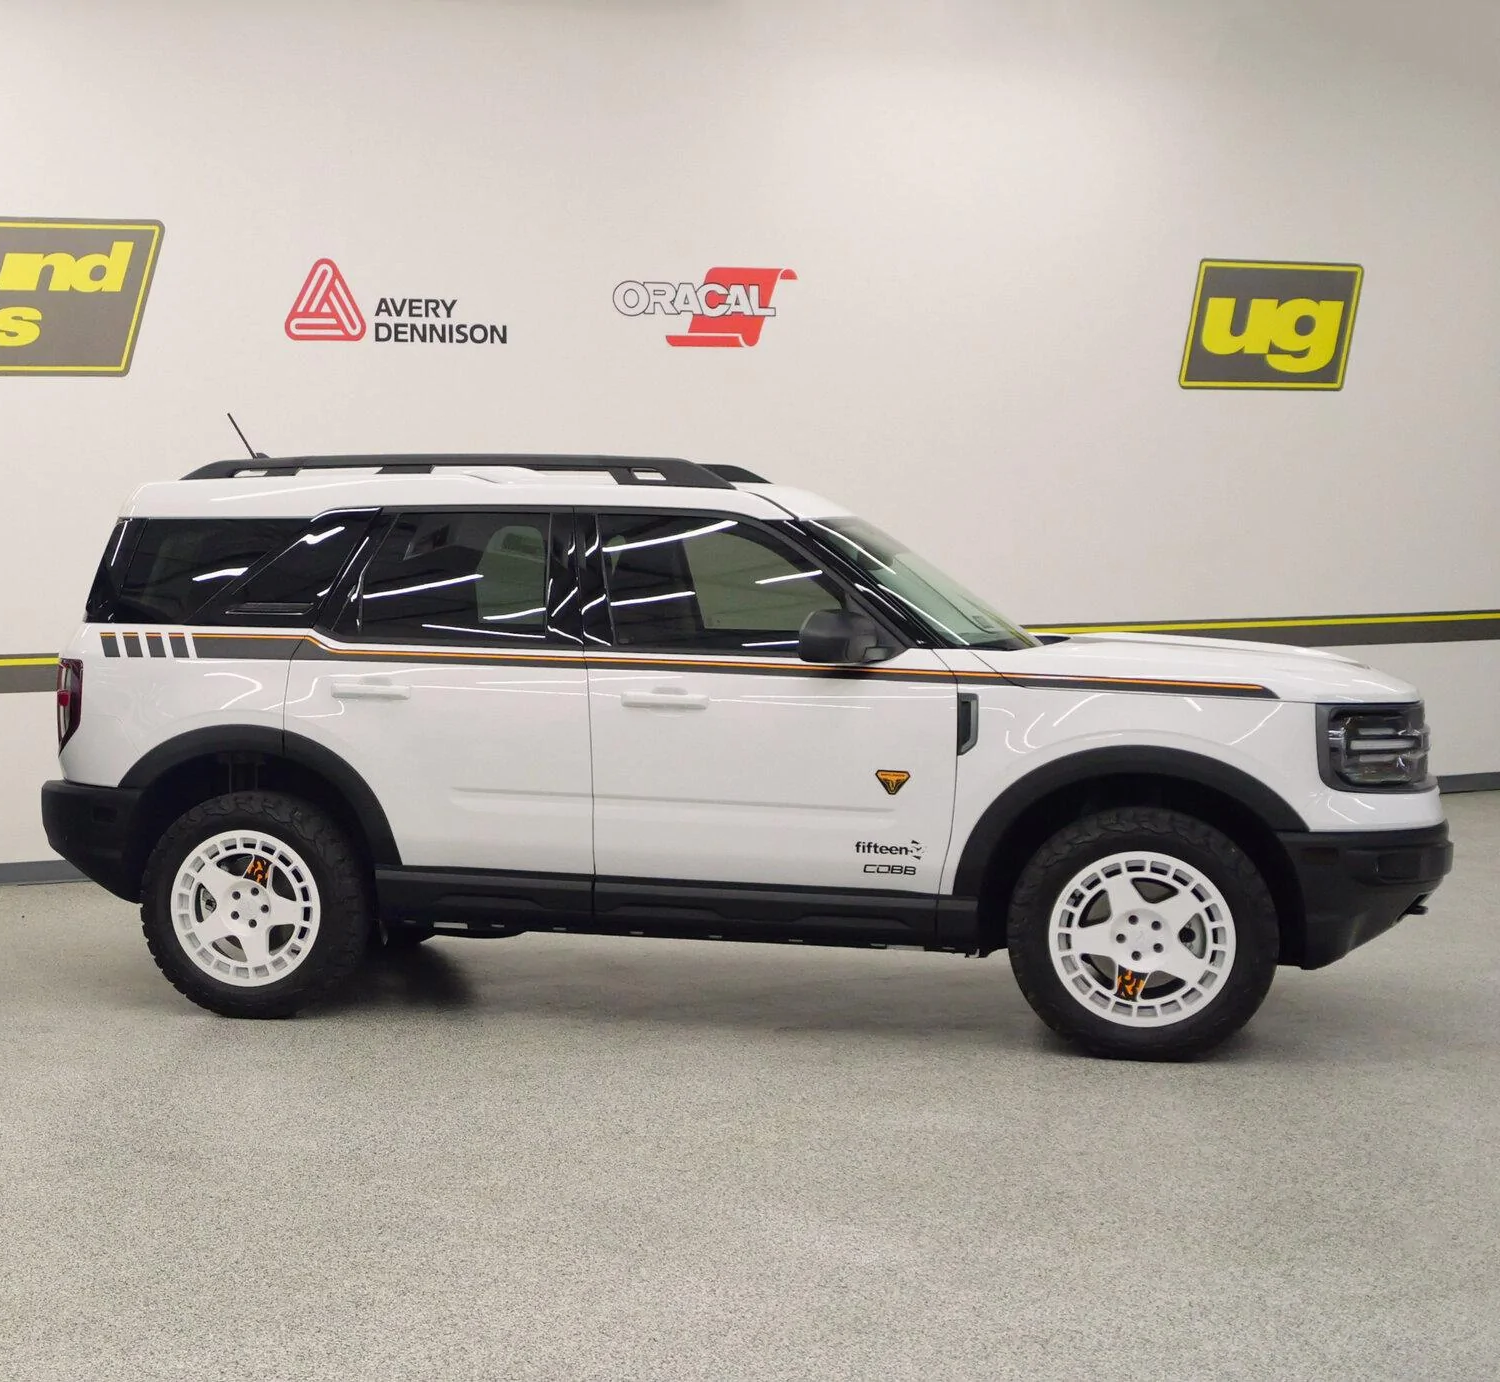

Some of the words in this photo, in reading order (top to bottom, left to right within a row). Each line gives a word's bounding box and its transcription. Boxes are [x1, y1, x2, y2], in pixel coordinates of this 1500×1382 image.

[374, 297, 458, 318] AVERY
[613, 280, 777, 317] ORACAL
[374, 322, 507, 344] DENNISON
[1202, 297, 1344, 373] ug
[863, 864, 916, 875] COBB
